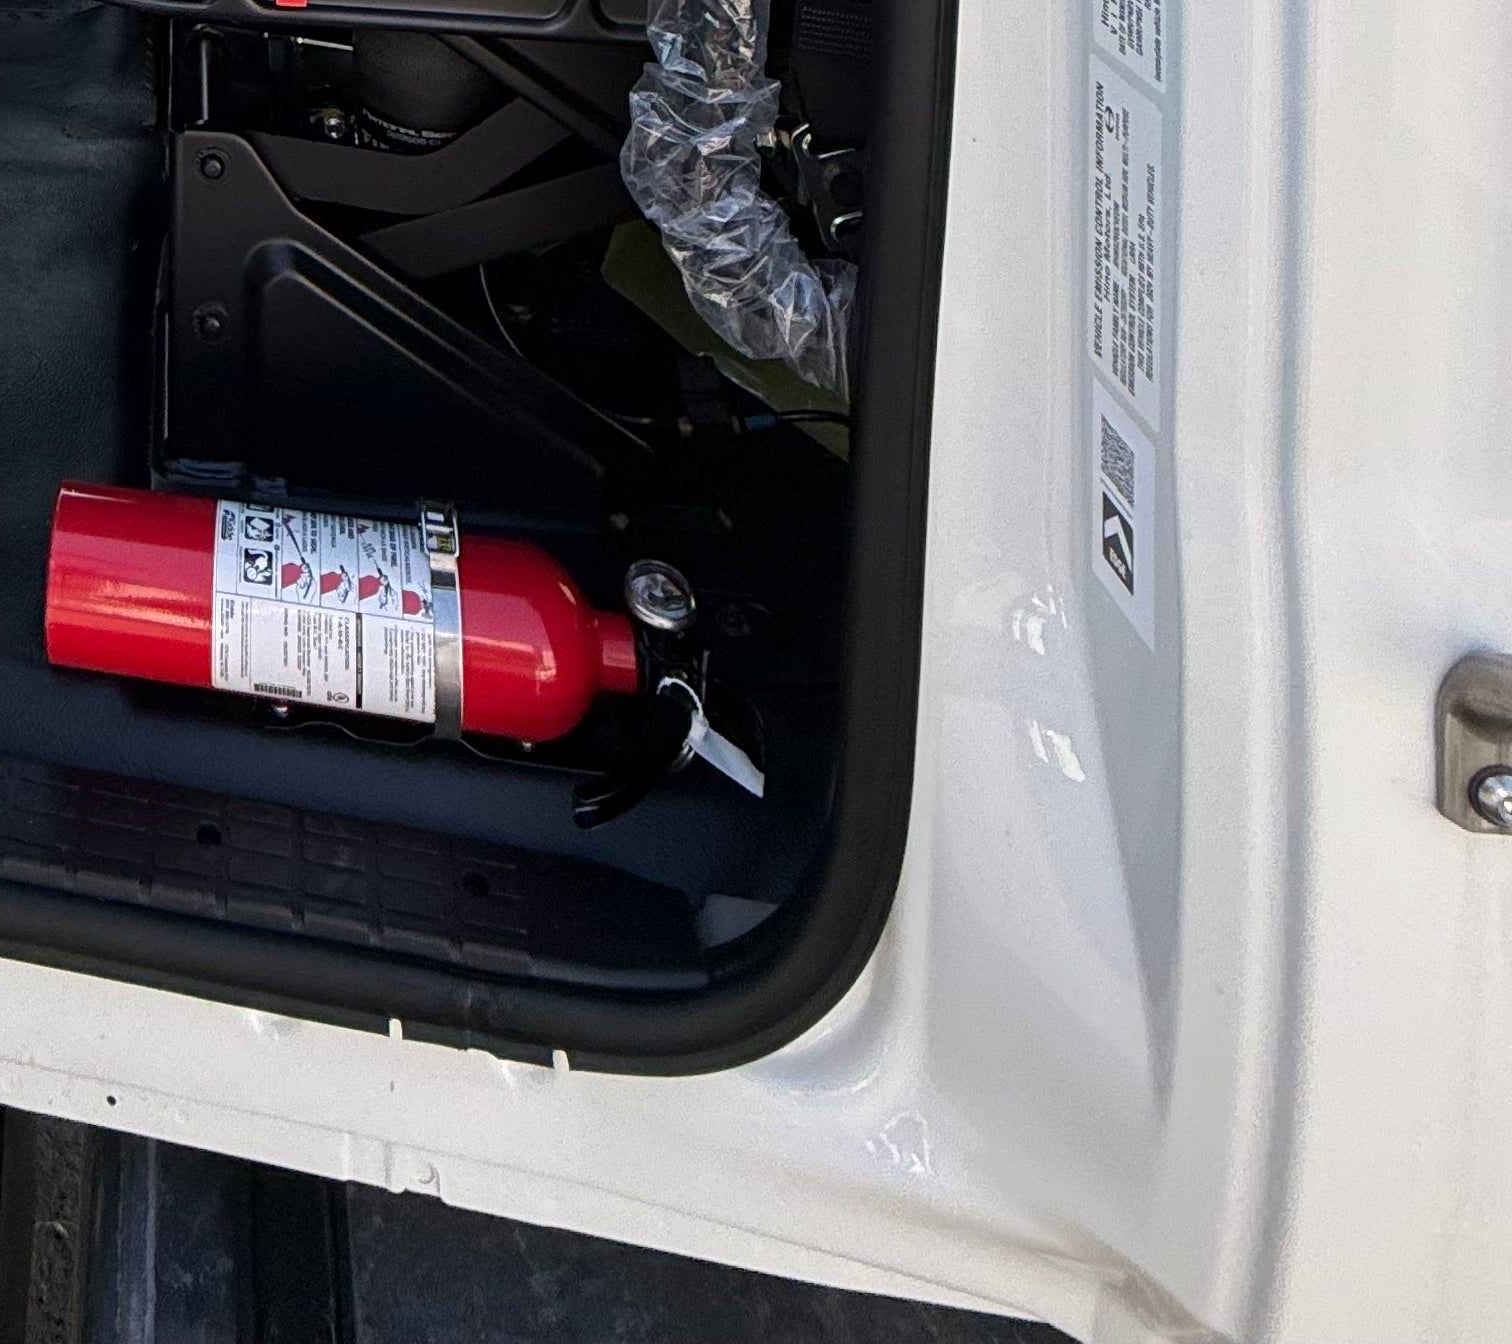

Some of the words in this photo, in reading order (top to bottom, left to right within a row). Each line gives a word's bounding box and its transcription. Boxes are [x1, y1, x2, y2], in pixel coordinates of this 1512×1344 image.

[1095, 81, 1104, 173] INFORMATION
[1095, 176, 1103, 236] CONTROL
[1094, 238, 1103, 302] EMISSION
[1094, 303, 1103, 359] VEHICLE
